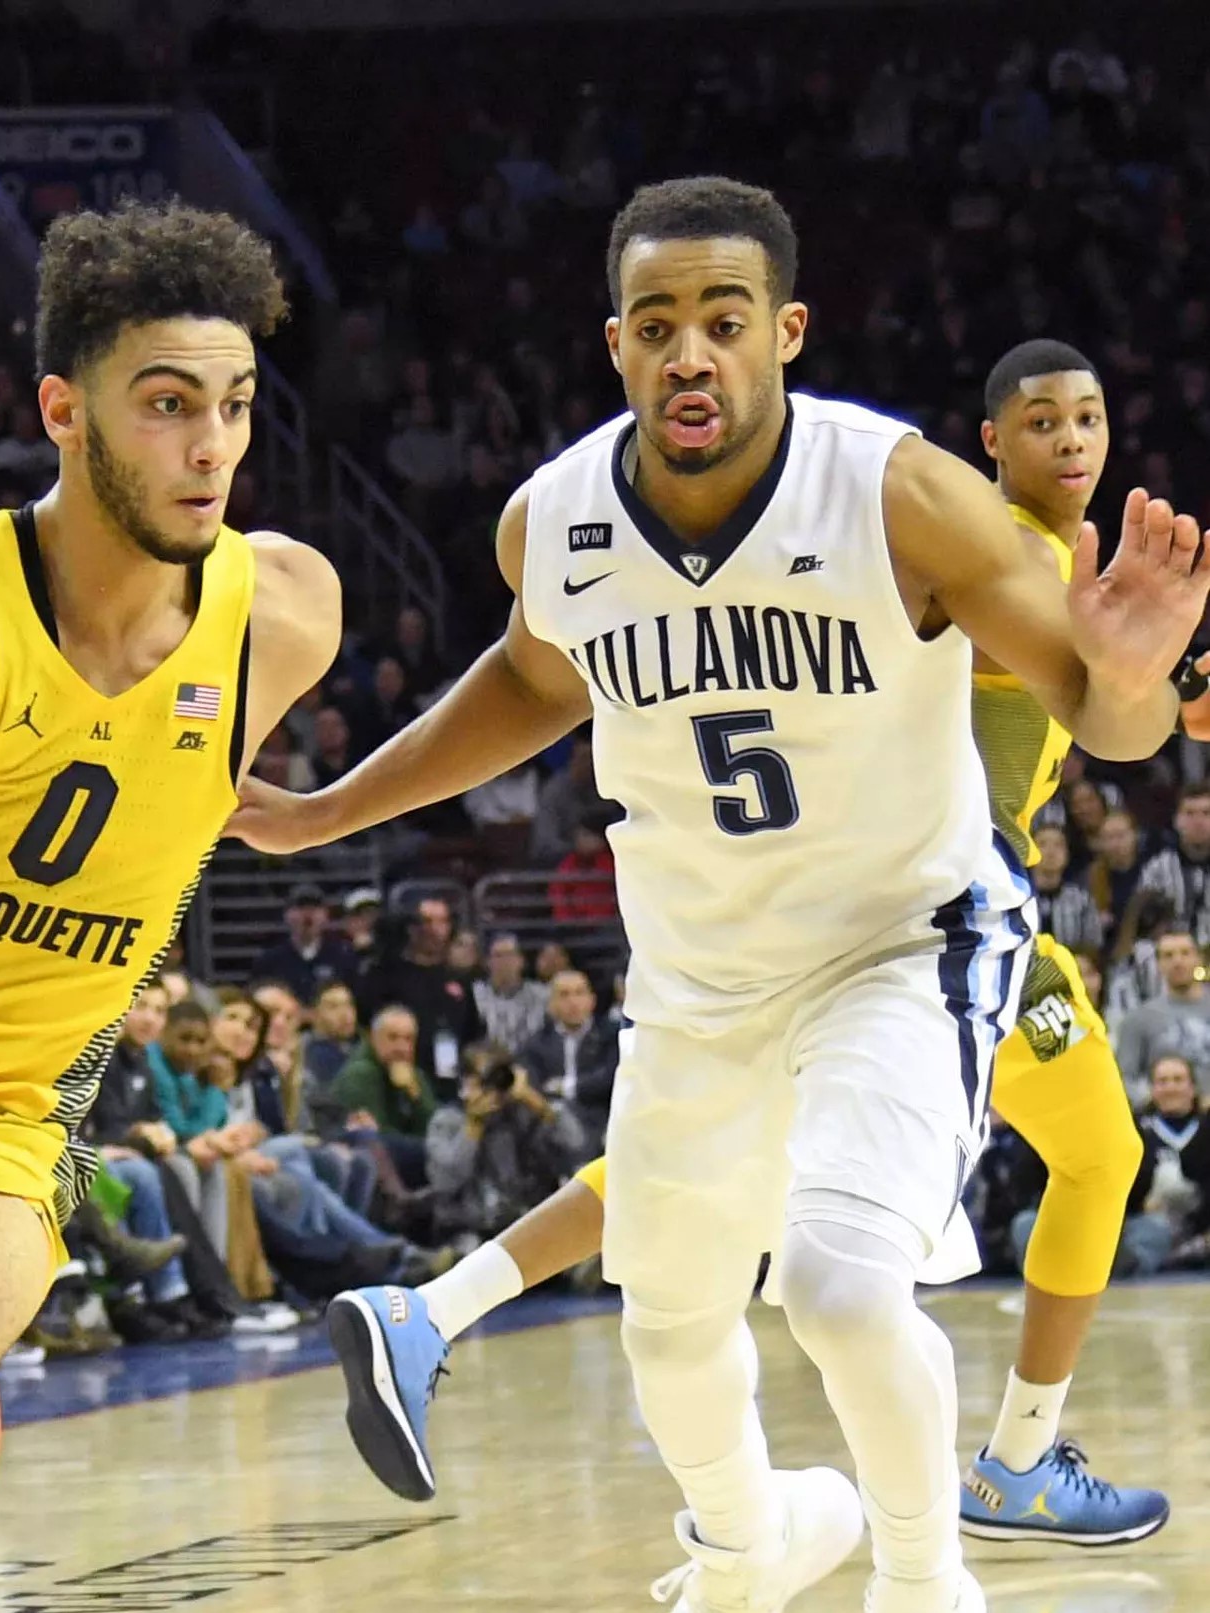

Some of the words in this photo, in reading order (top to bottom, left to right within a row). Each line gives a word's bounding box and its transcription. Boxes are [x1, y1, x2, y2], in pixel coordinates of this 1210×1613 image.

[571, 527, 605, 546] RVM
[569, 605, 879, 708] VILLANOVA
[89, 720, 112, 741] AL
[690, 709, 799, 836] 5
[8, 760, 119, 887] 0
